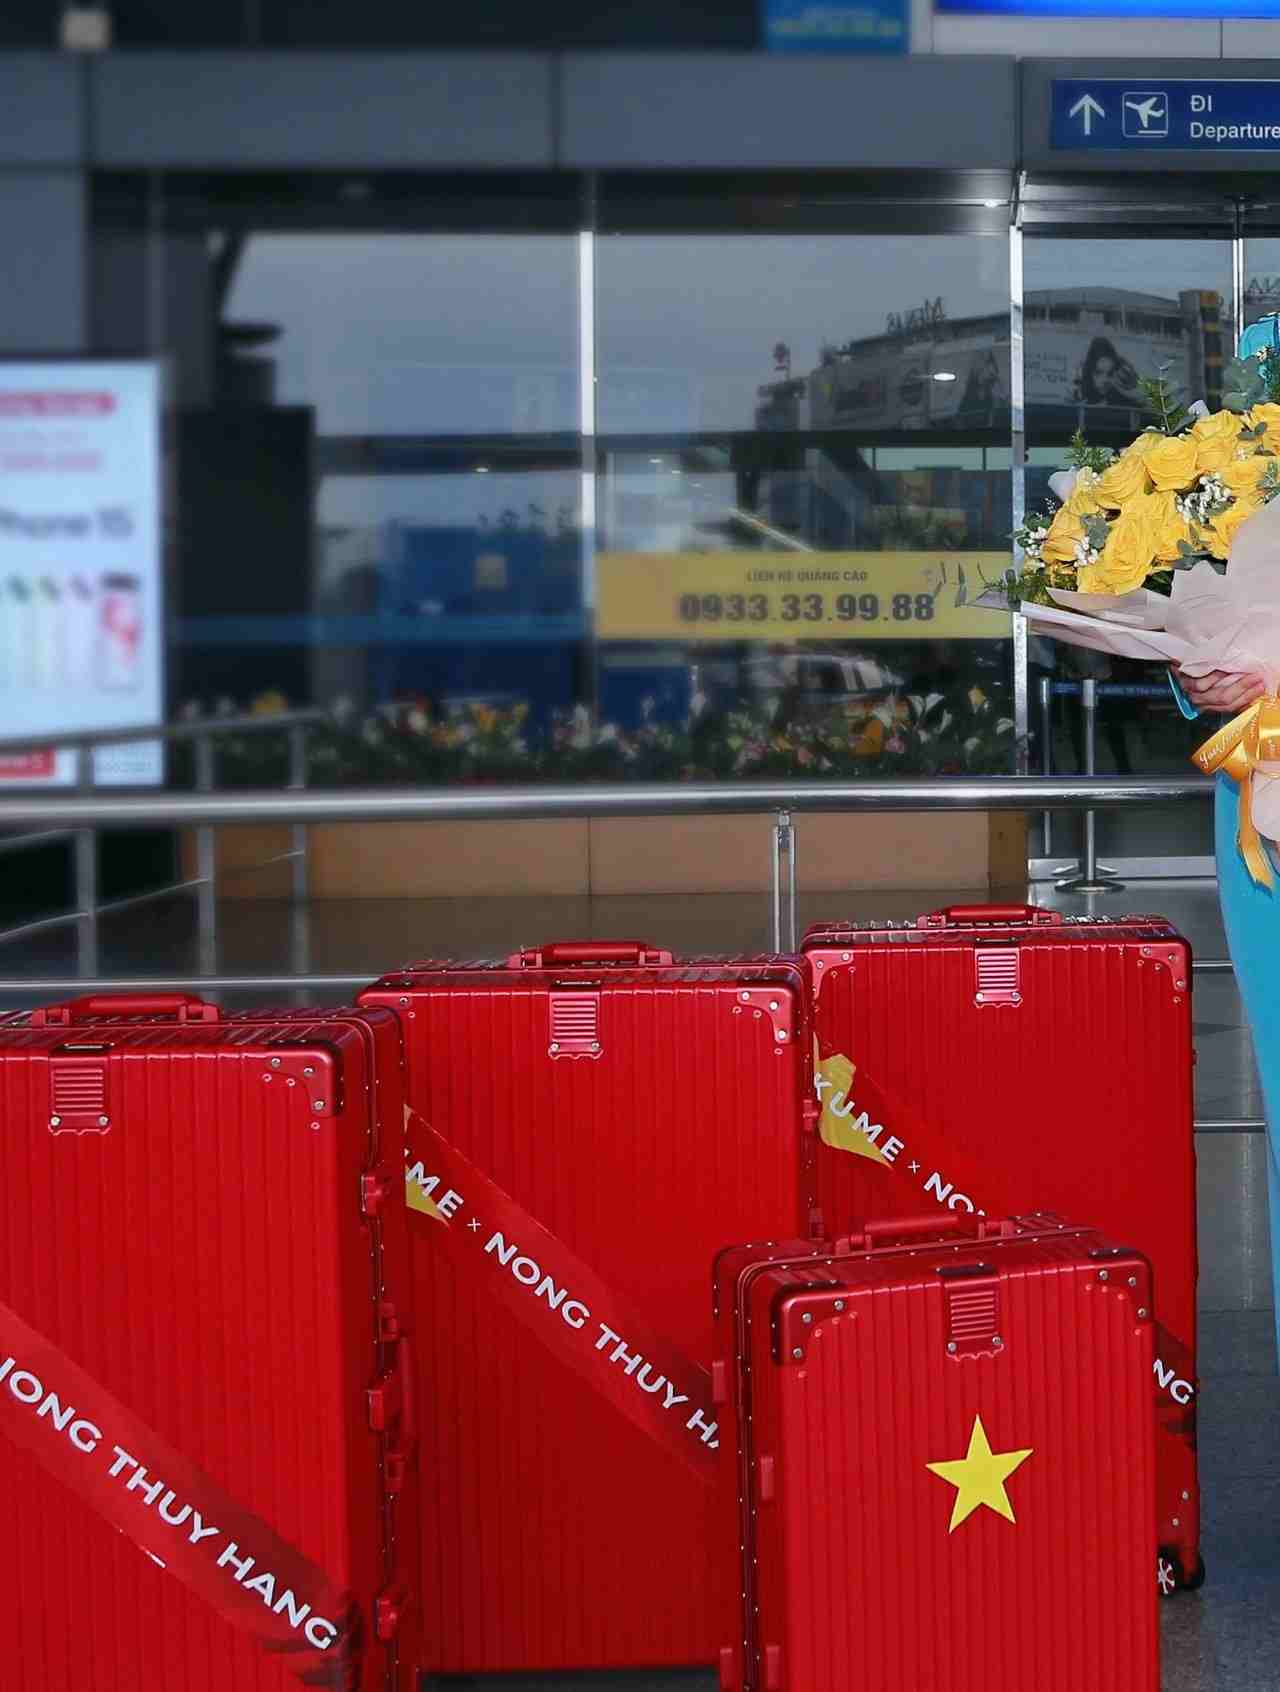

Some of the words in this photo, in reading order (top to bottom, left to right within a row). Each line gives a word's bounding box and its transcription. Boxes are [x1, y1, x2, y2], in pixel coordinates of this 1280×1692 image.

[1190, 94, 1213, 112] ĐI
[679, 592, 935, 622] 0933.33.99.88
[484, 1231, 590, 1329] NONG
[595, 1322, 689, 1409] THUY
[108, 1445, 220, 1544] THUY
[216, 1542, 338, 1650] HANG
